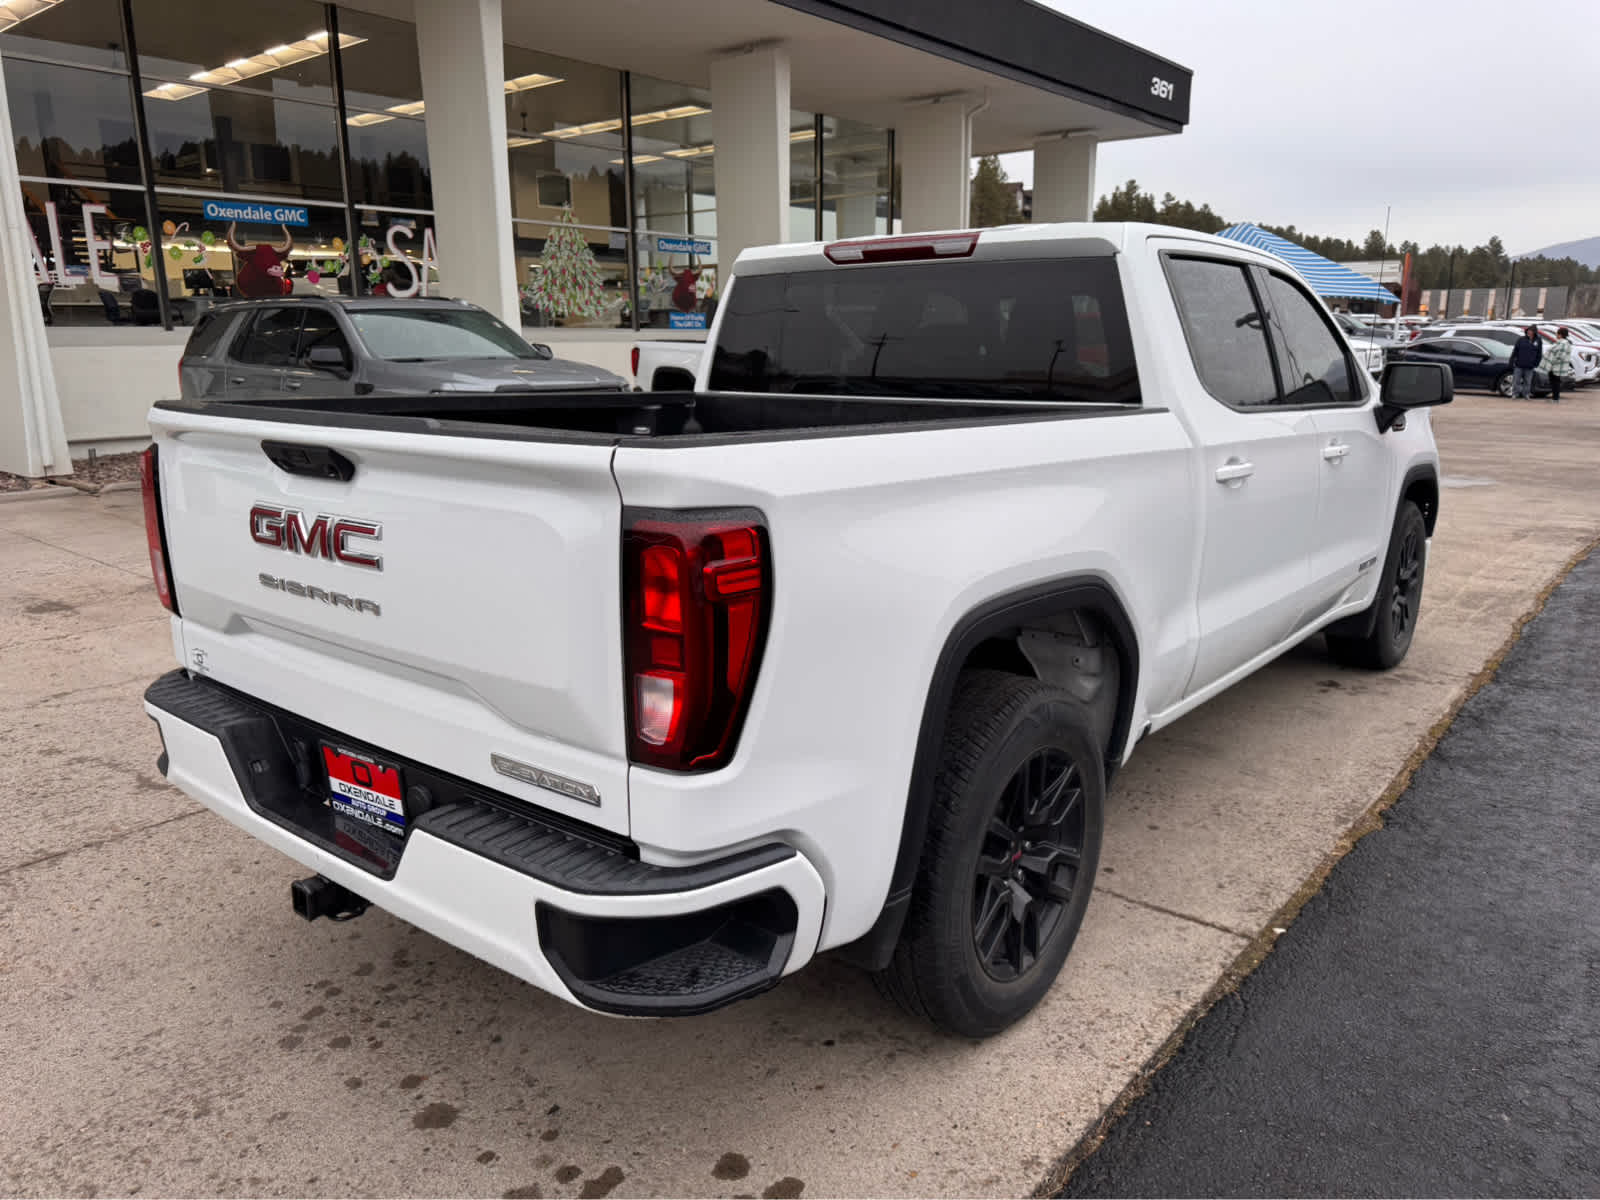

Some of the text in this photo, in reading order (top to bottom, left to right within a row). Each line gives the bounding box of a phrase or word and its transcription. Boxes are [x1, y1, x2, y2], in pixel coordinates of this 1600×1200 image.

[1150, 76, 1174, 101] 361
[206, 203, 305, 222] Oxendale GMC
[250, 501, 384, 572] GMC
[258, 573, 382, 616] SIERRA
[338, 782, 396, 810] OXENDALE
